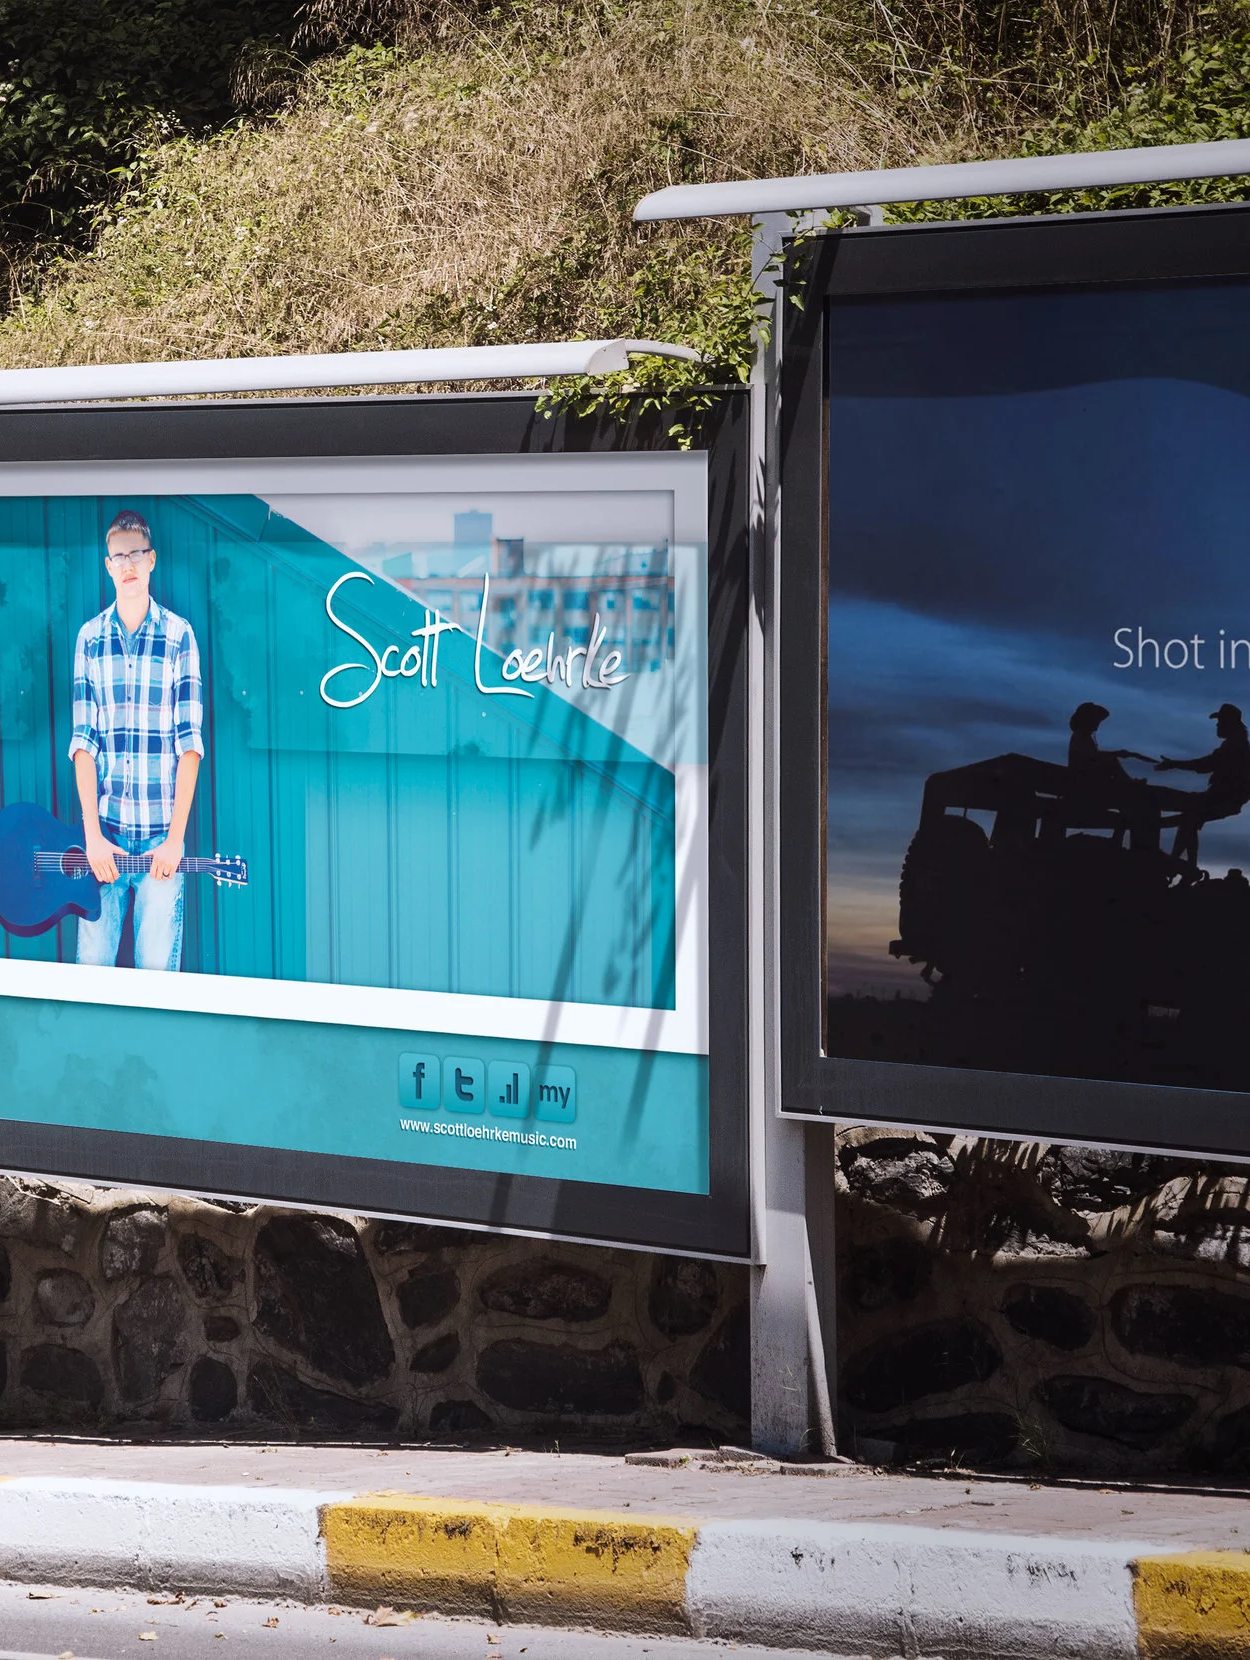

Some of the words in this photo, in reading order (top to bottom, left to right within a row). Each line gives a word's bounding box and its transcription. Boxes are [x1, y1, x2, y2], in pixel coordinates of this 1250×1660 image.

[319, 571, 463, 708] Scott
[475, 572, 630, 698] Loehrke
[1113, 626, 1205, 669] Shot
[1219, 629, 1250, 669] in
[539, 1084, 570, 1109] my
[400, 1119, 577, 1150] www.scottloehrkemusic.com
